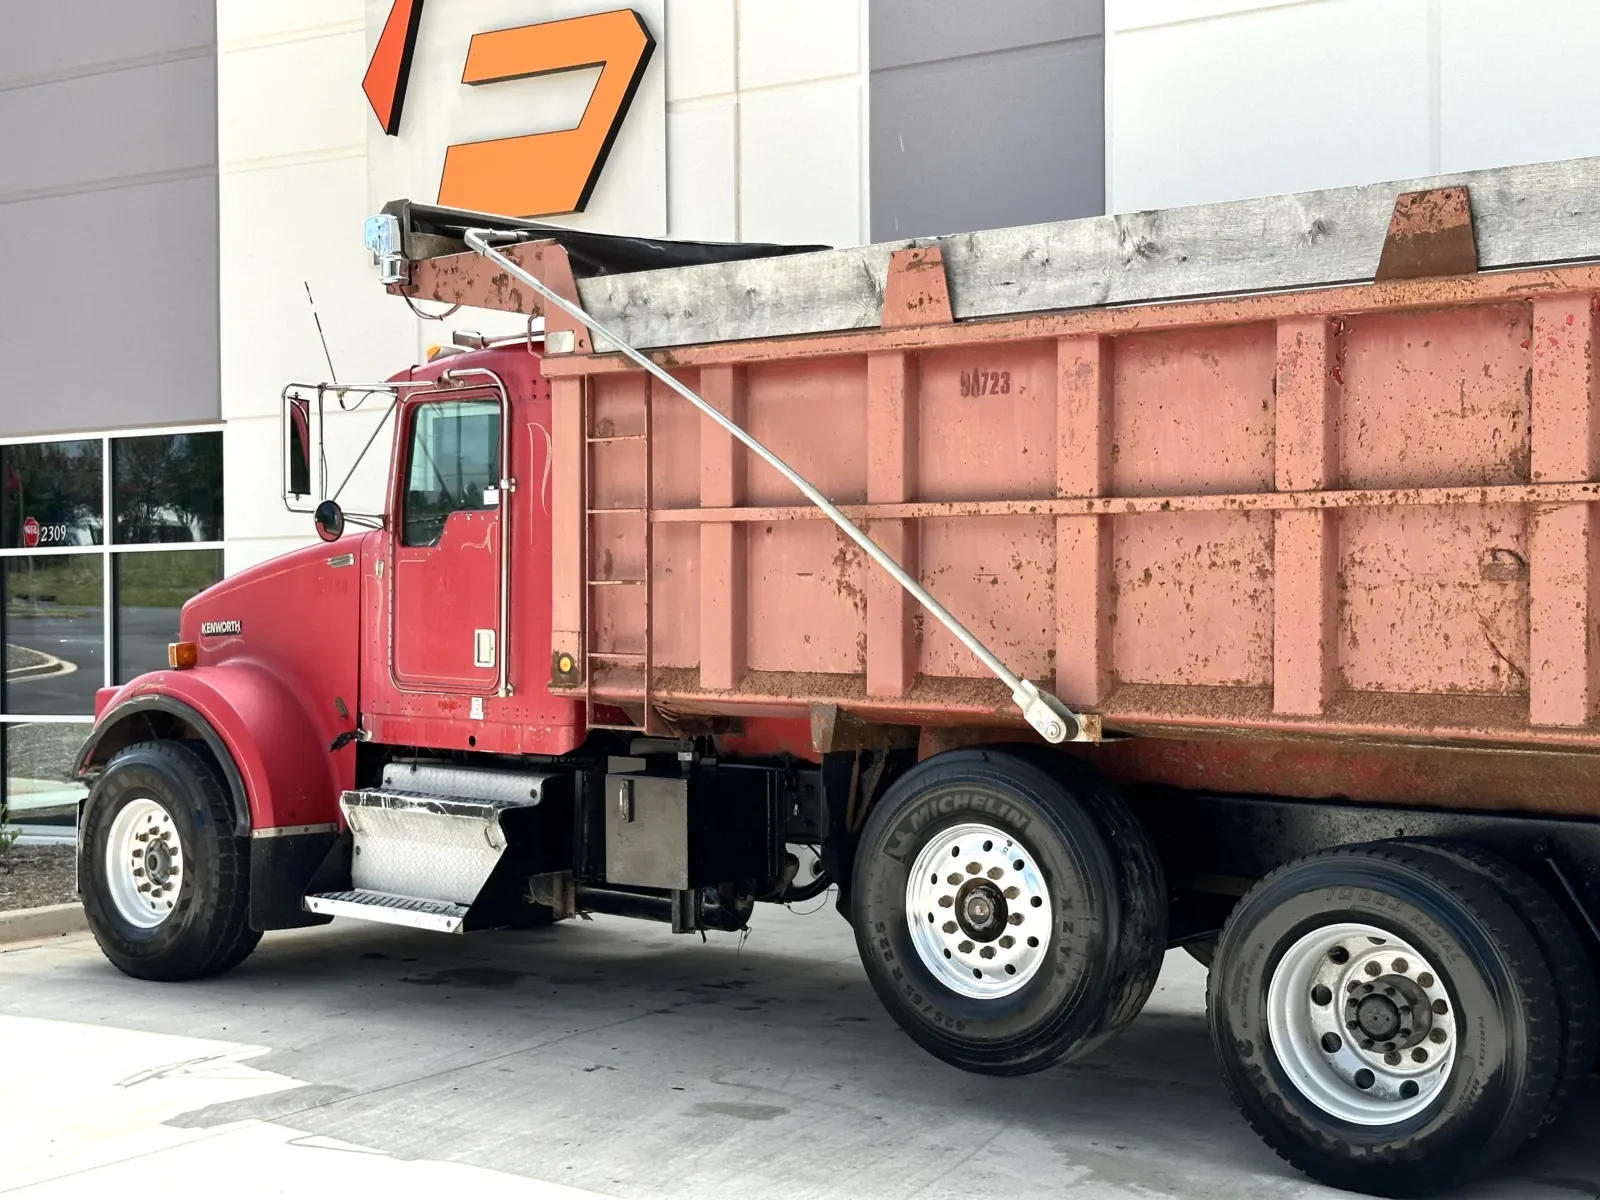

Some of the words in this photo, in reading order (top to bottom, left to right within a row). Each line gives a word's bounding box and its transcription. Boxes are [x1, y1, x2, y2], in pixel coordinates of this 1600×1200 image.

[41, 525, 67, 542] 2309
[201, 620, 241, 634] KENWORTH
[909, 794, 1030, 833] MICHELIN
[1410, 914, 1461, 962] RADIAL
